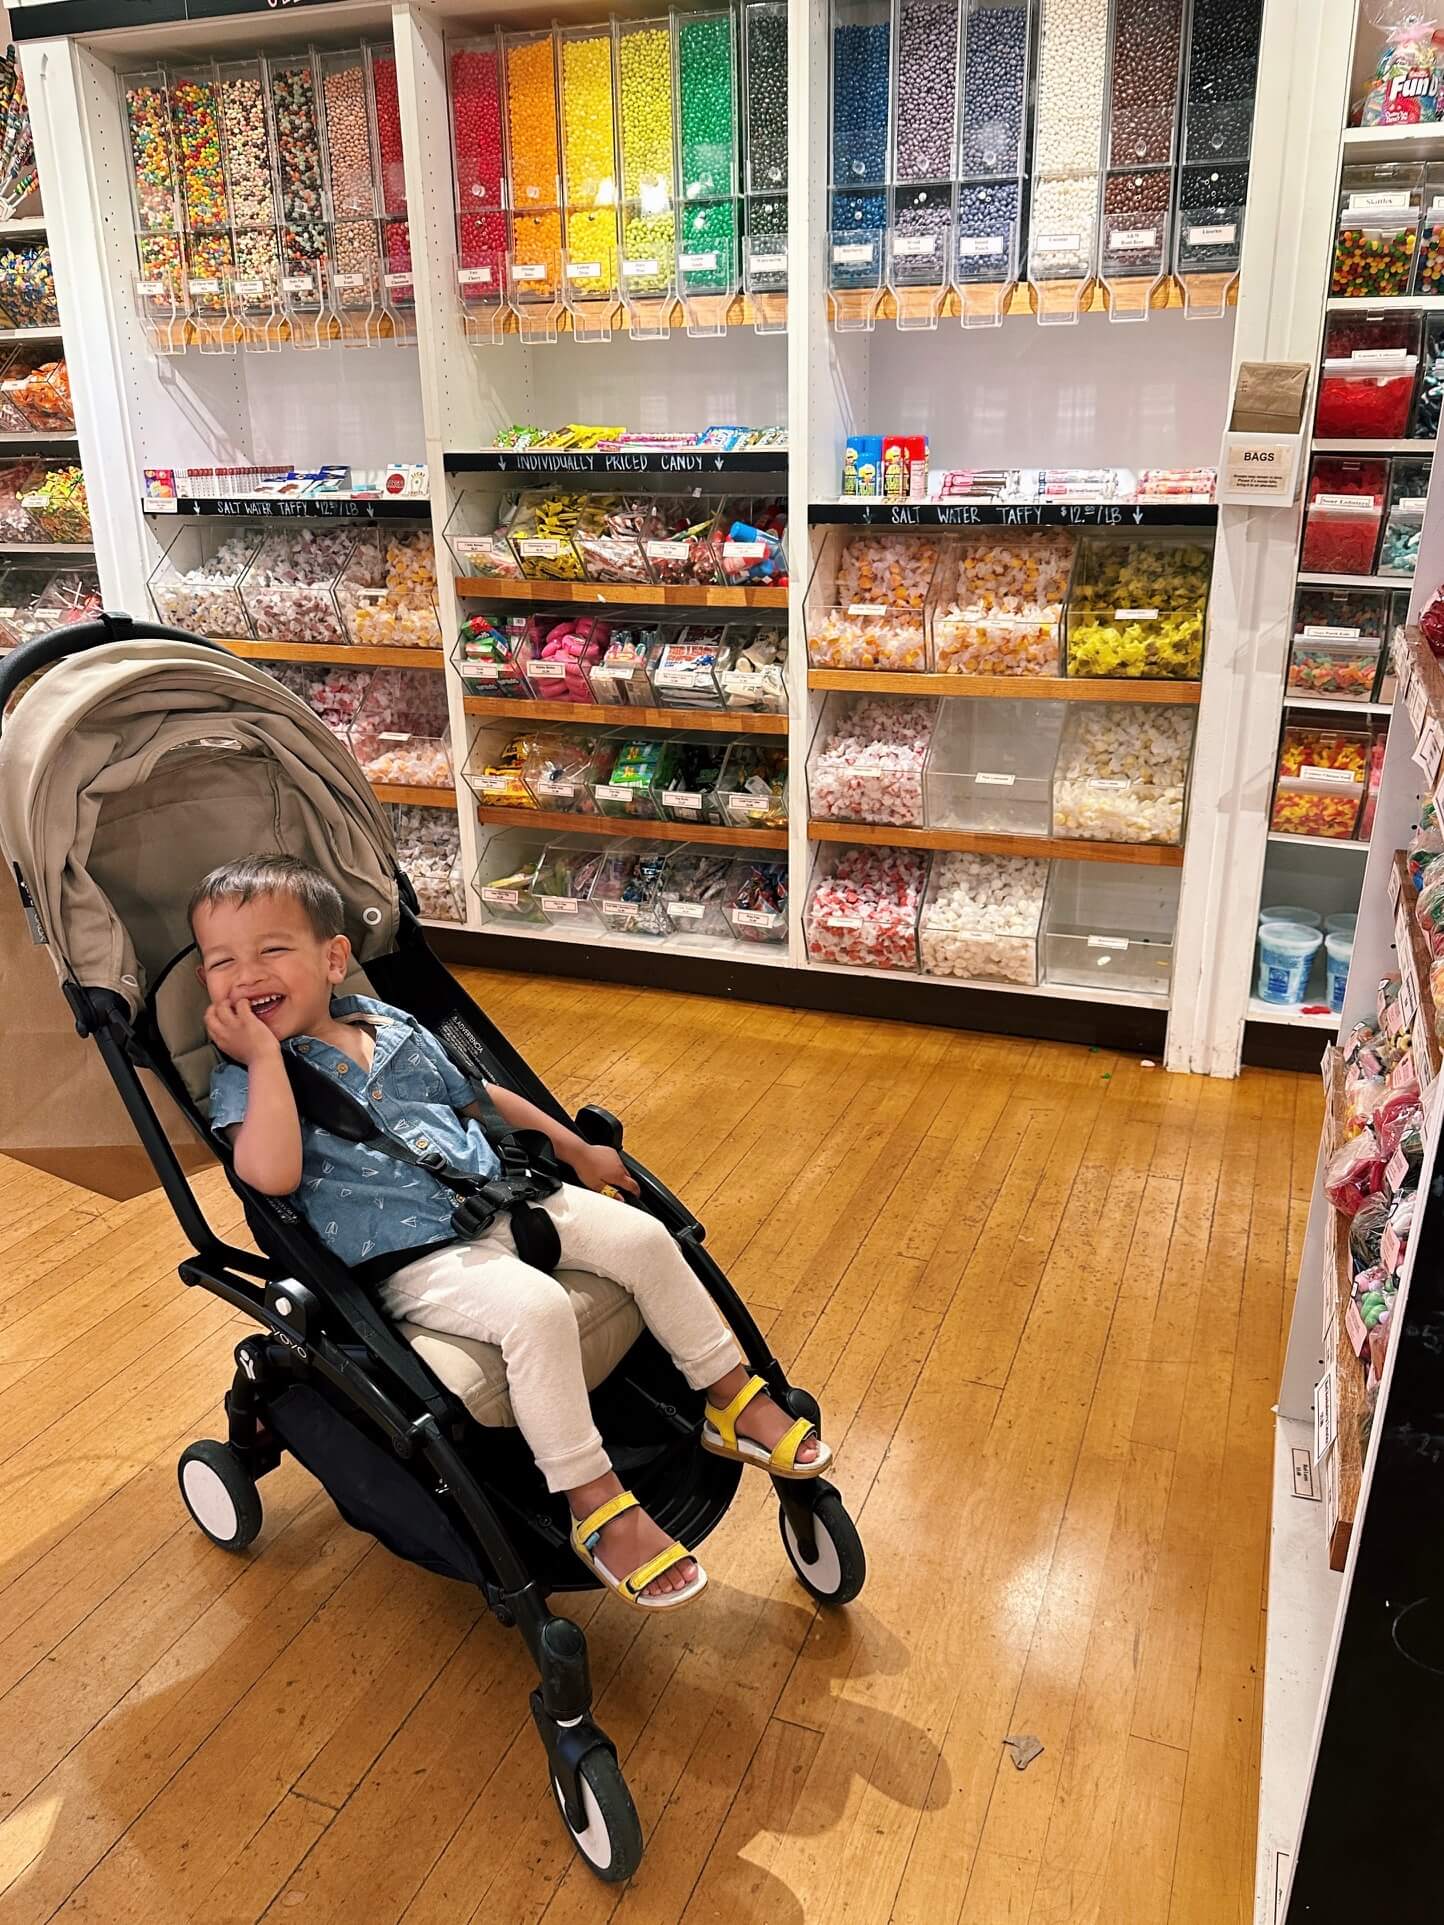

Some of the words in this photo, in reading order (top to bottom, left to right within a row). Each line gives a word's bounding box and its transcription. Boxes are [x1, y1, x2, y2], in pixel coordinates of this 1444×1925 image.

[1390, 76, 1430, 101] Fun
[517, 455, 594, 471] INDIVIDUALLY
[606, 455, 648, 471] PRICED
[661, 455, 703, 471] CANDY
[1244, 452, 1275, 462] BAGS
[217, 501, 241, 514] SALT
[244, 501, 273, 515] WATER
[278, 501, 308, 516] TAFFY
[891, 506, 921, 524] SALT
[937, 506, 981, 524] WATER
[996, 506, 1042, 524] TAFFY
